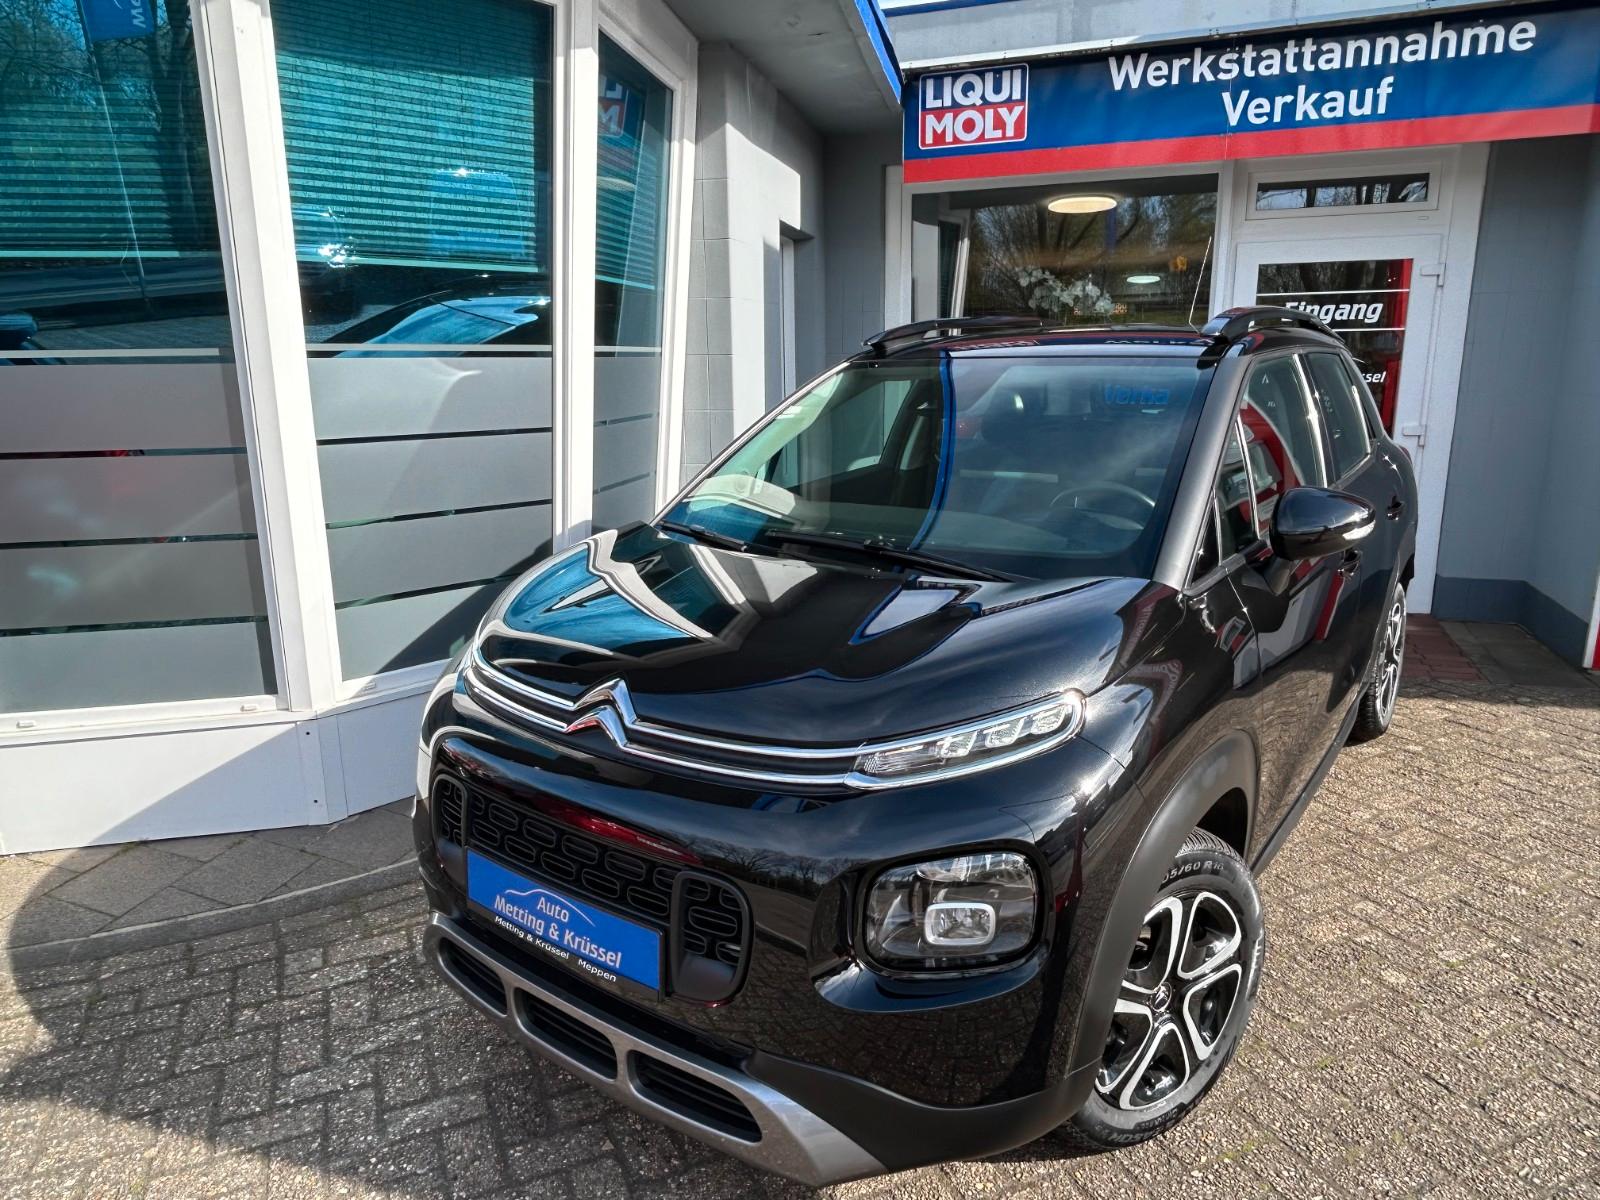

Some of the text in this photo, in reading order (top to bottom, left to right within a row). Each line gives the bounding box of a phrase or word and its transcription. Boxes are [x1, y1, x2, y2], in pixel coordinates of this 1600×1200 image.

[1109, 21, 1536, 90] Werkstattannahme
[925, 69, 1022, 109] LIQUI
[1222, 78, 1393, 127] Verkauf
[924, 105, 1025, 144] MOLY
[494, 895, 621, 968] Metting & Krüssel
[537, 897, 569, 922] Auto
[495, 916, 617, 982] Metting & Krüssel Meppen
